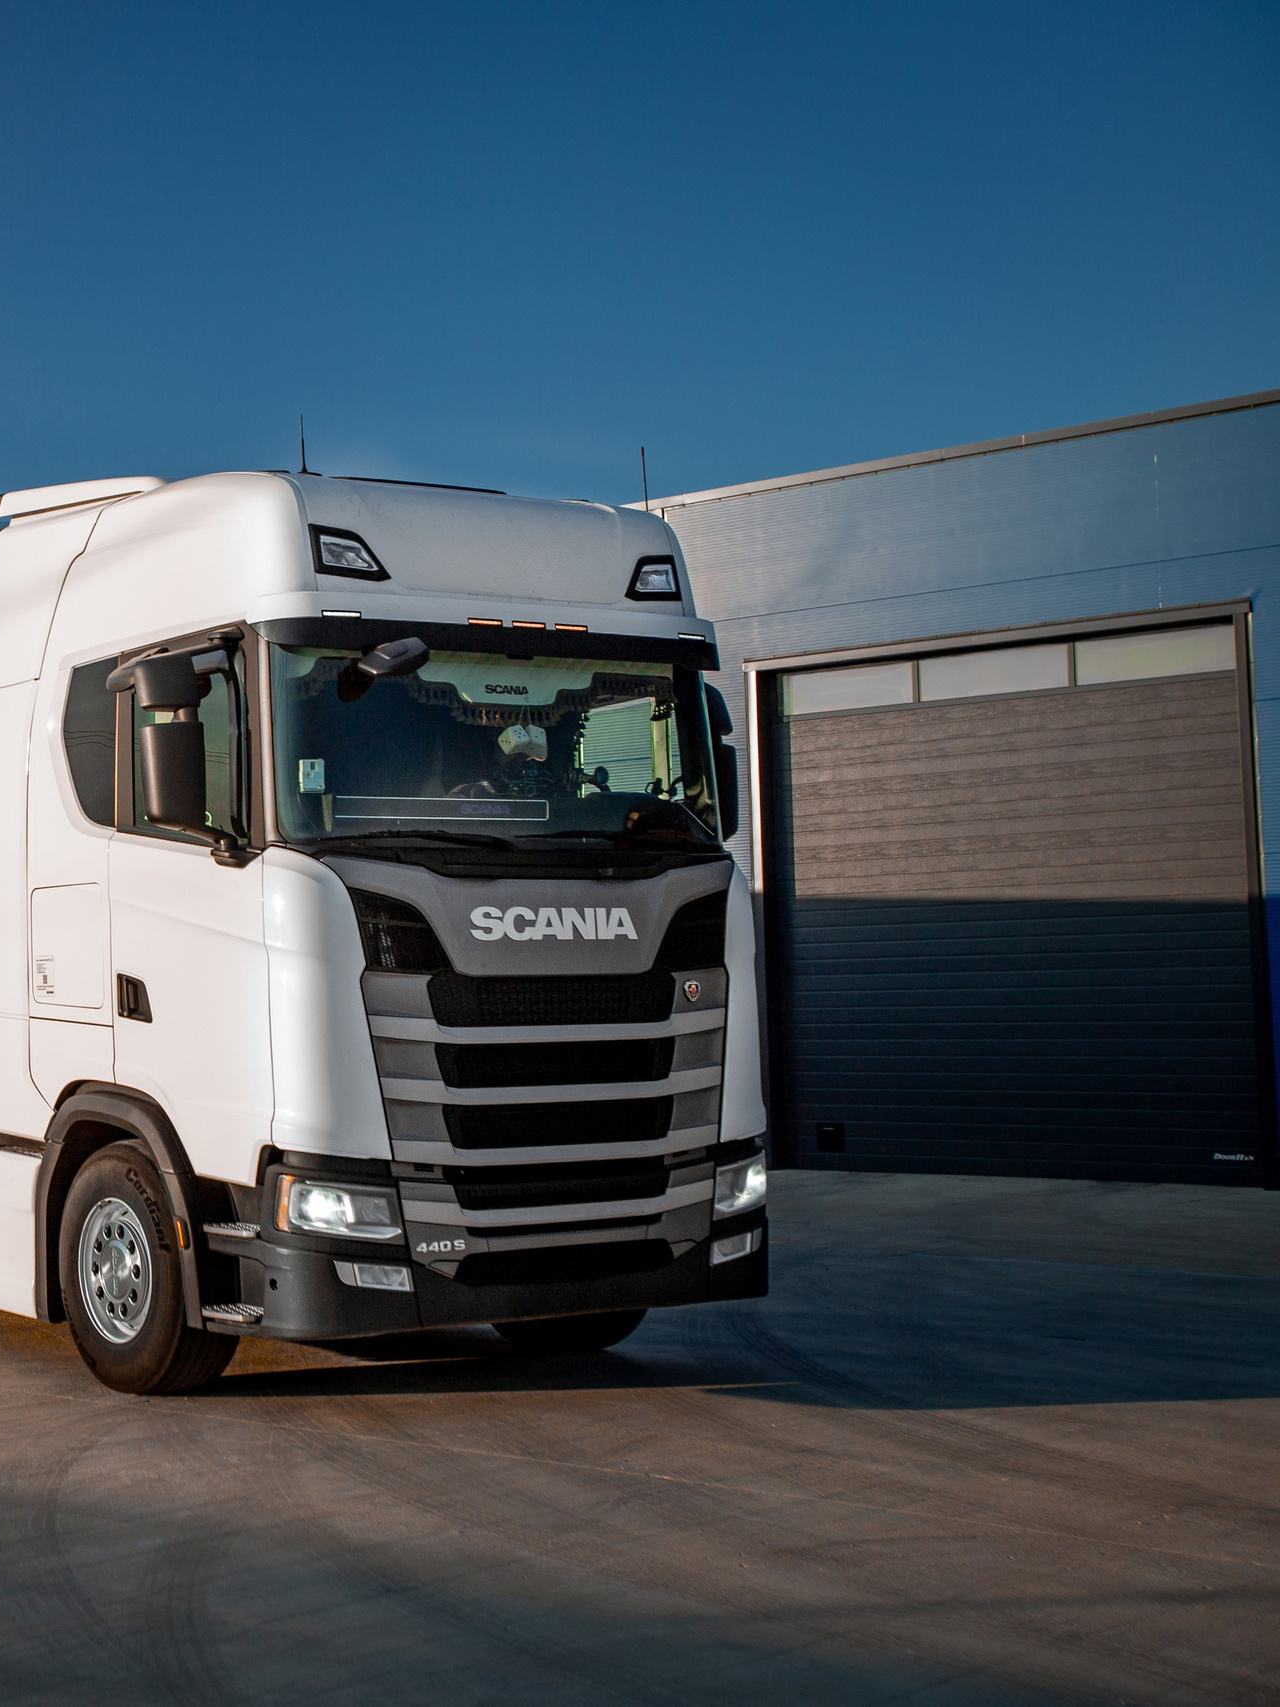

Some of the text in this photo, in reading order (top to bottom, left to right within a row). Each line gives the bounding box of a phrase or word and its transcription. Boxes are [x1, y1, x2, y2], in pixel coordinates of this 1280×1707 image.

[484, 684, 528, 696] SCANIA
[470, 906, 638, 941] SCANIA
[125, 1167, 170, 1251] Cordiant
